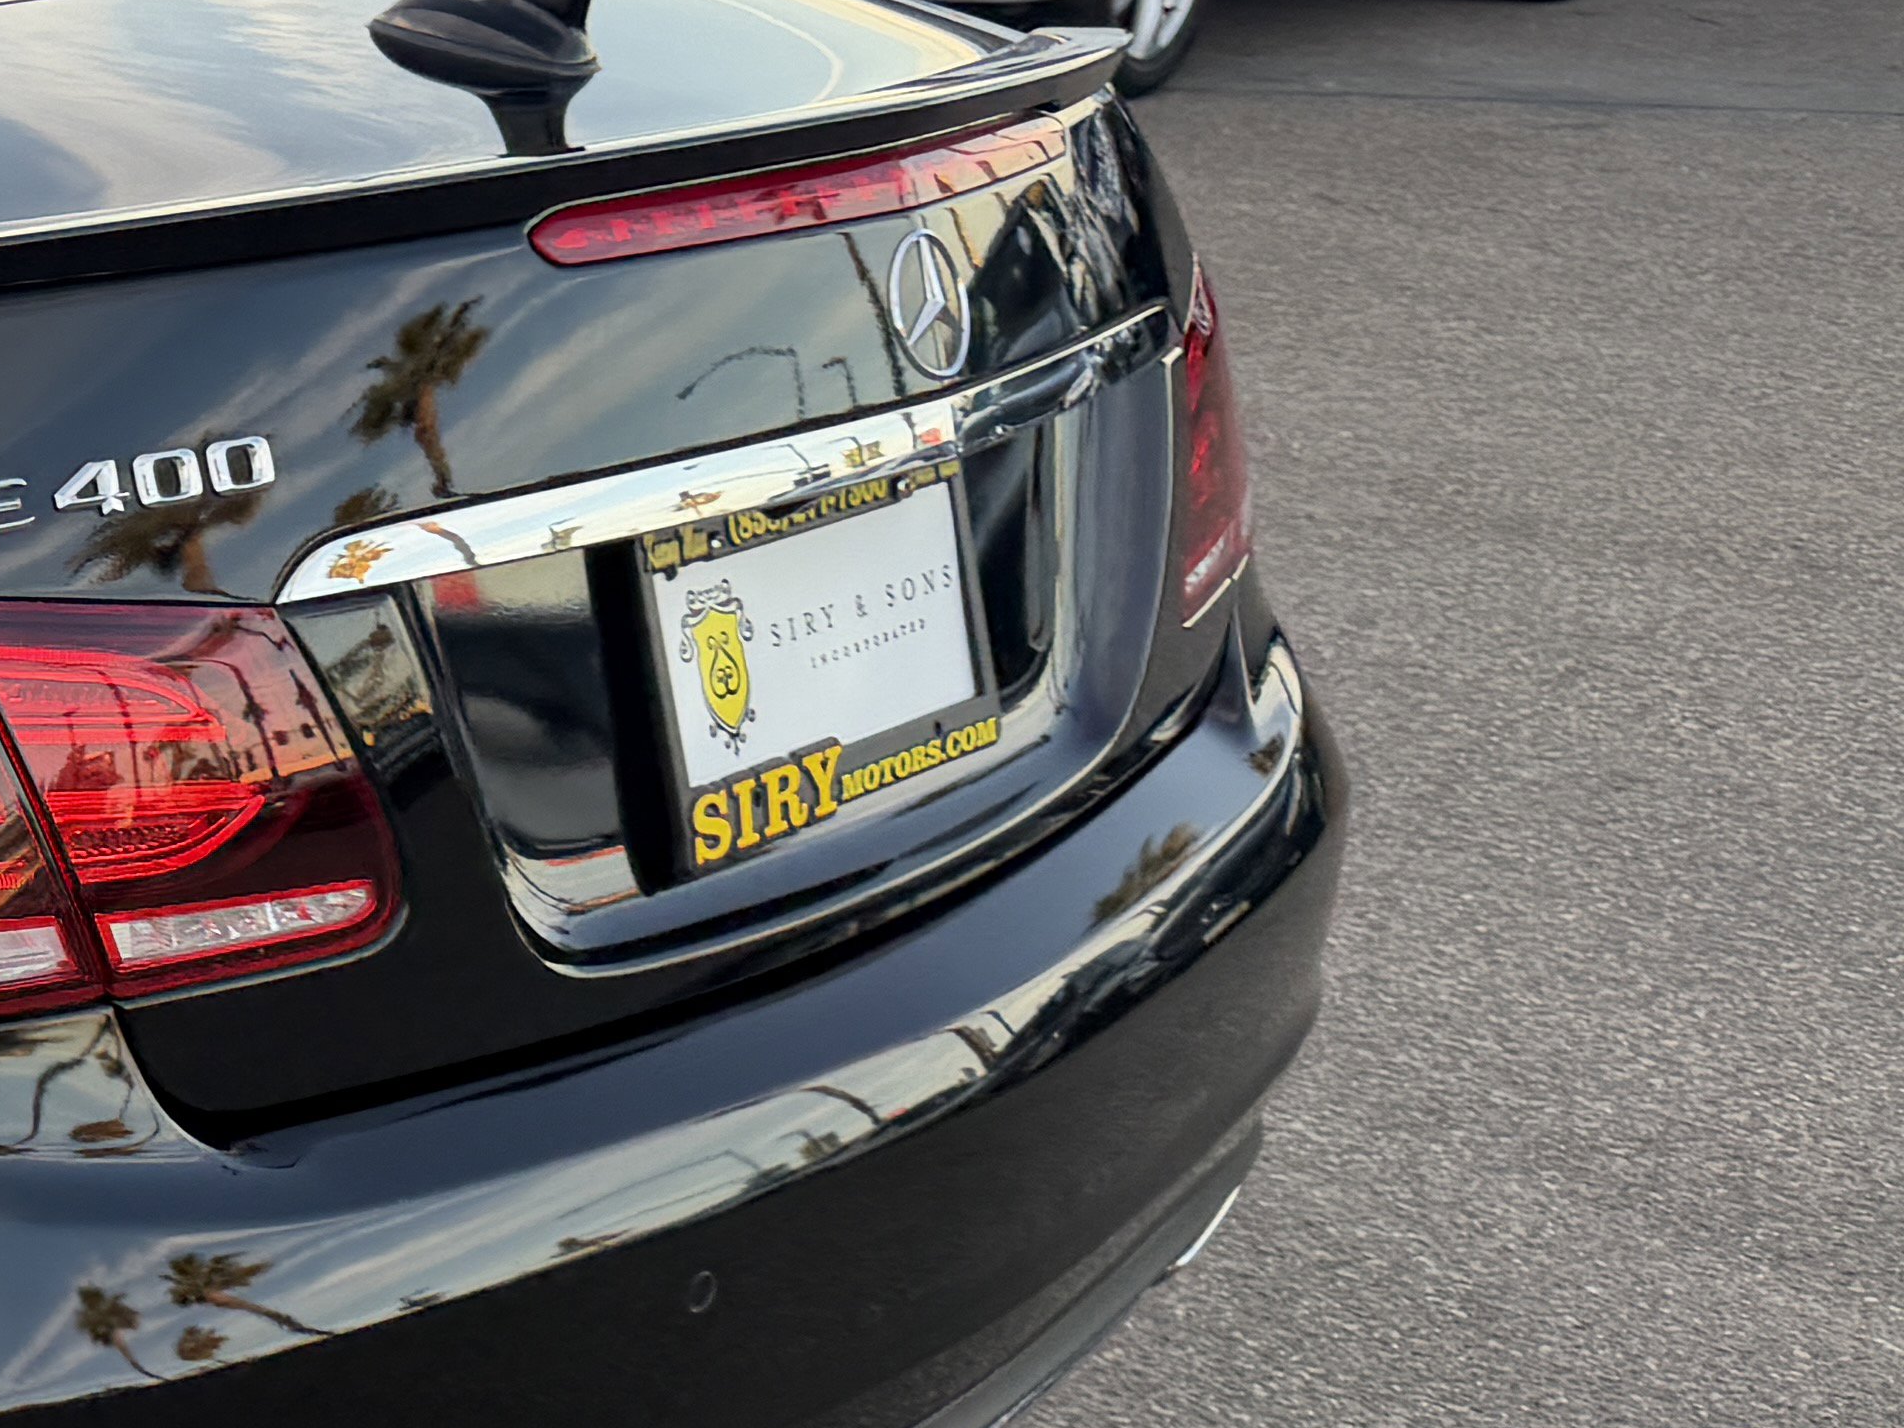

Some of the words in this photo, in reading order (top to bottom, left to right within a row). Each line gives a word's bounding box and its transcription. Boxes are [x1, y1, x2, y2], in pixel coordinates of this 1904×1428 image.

[53, 434, 277, 517] 400
[771, 603, 835, 648] SIRY
[854, 593, 869, 619] &
[884, 563, 954, 608] SONS
